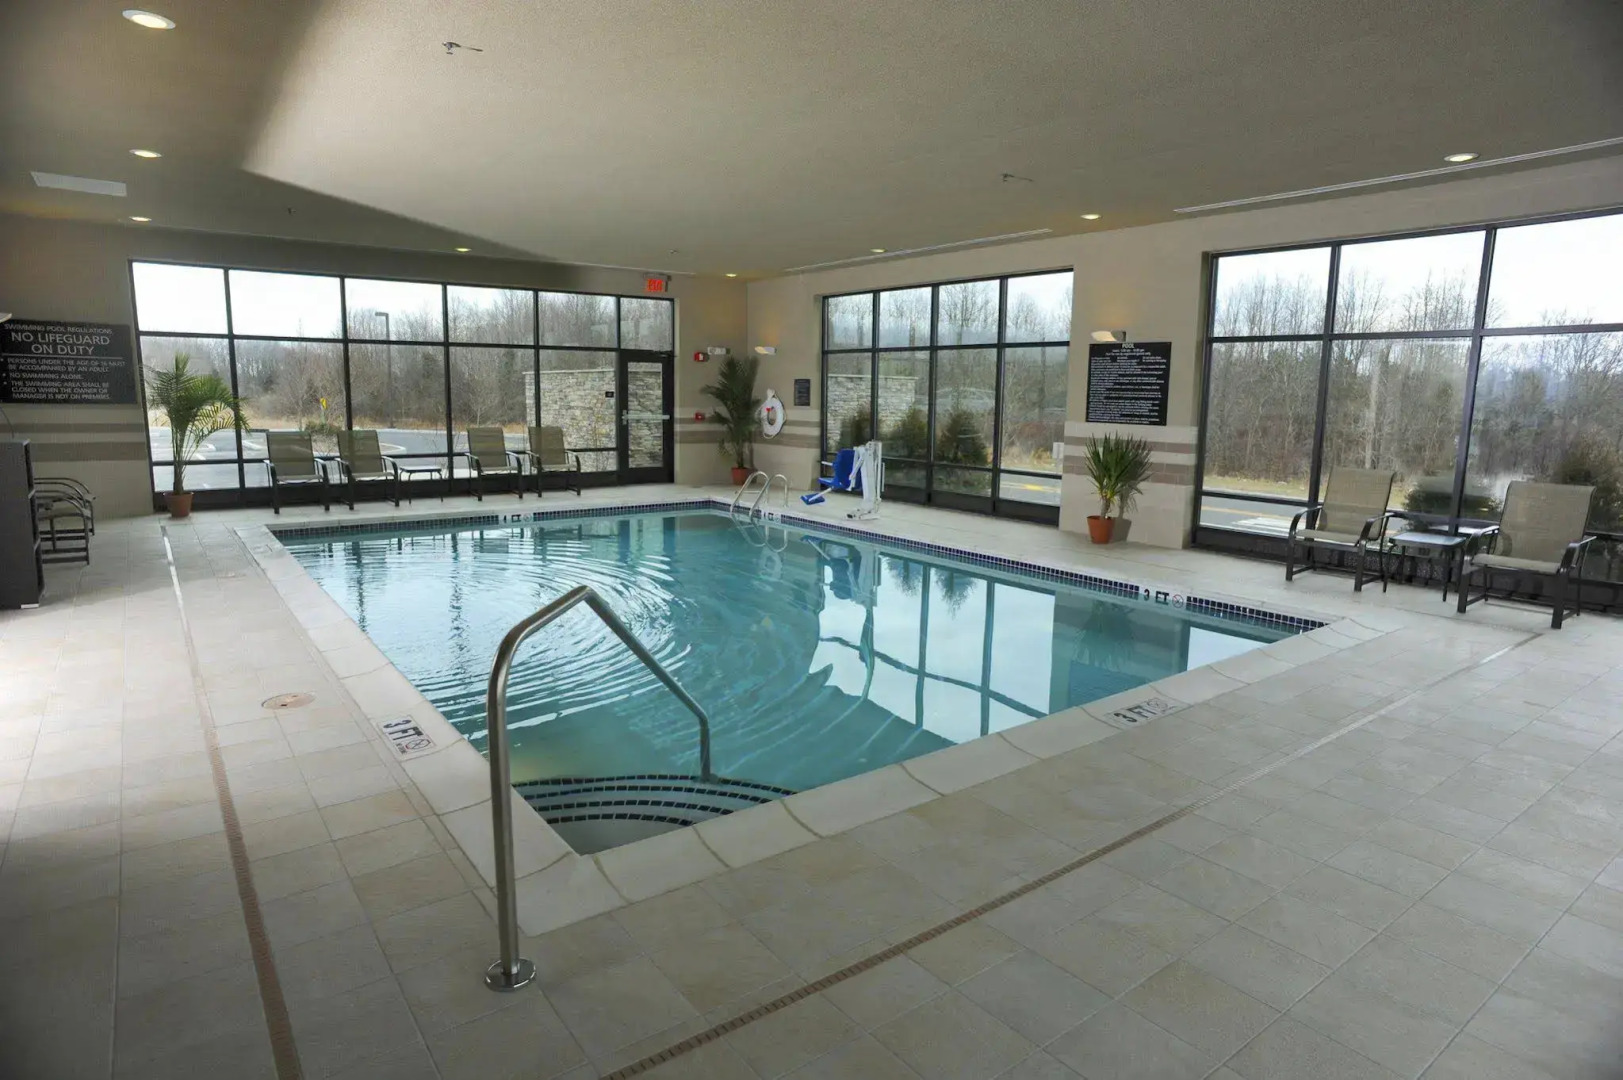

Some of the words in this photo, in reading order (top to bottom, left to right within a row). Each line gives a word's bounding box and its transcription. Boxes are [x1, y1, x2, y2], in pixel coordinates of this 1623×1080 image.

[4, 323, 45, 331] SWIMMING
[11, 332, 34, 342] NO
[38, 333, 111, 345] LIFEGUARD
[31, 344, 53, 354] ON
[57, 345, 95, 355] DUTY
[1113, 712, 1138, 723] 3
[1126, 704, 1157, 719] FT
[388, 726, 424, 741] FT
